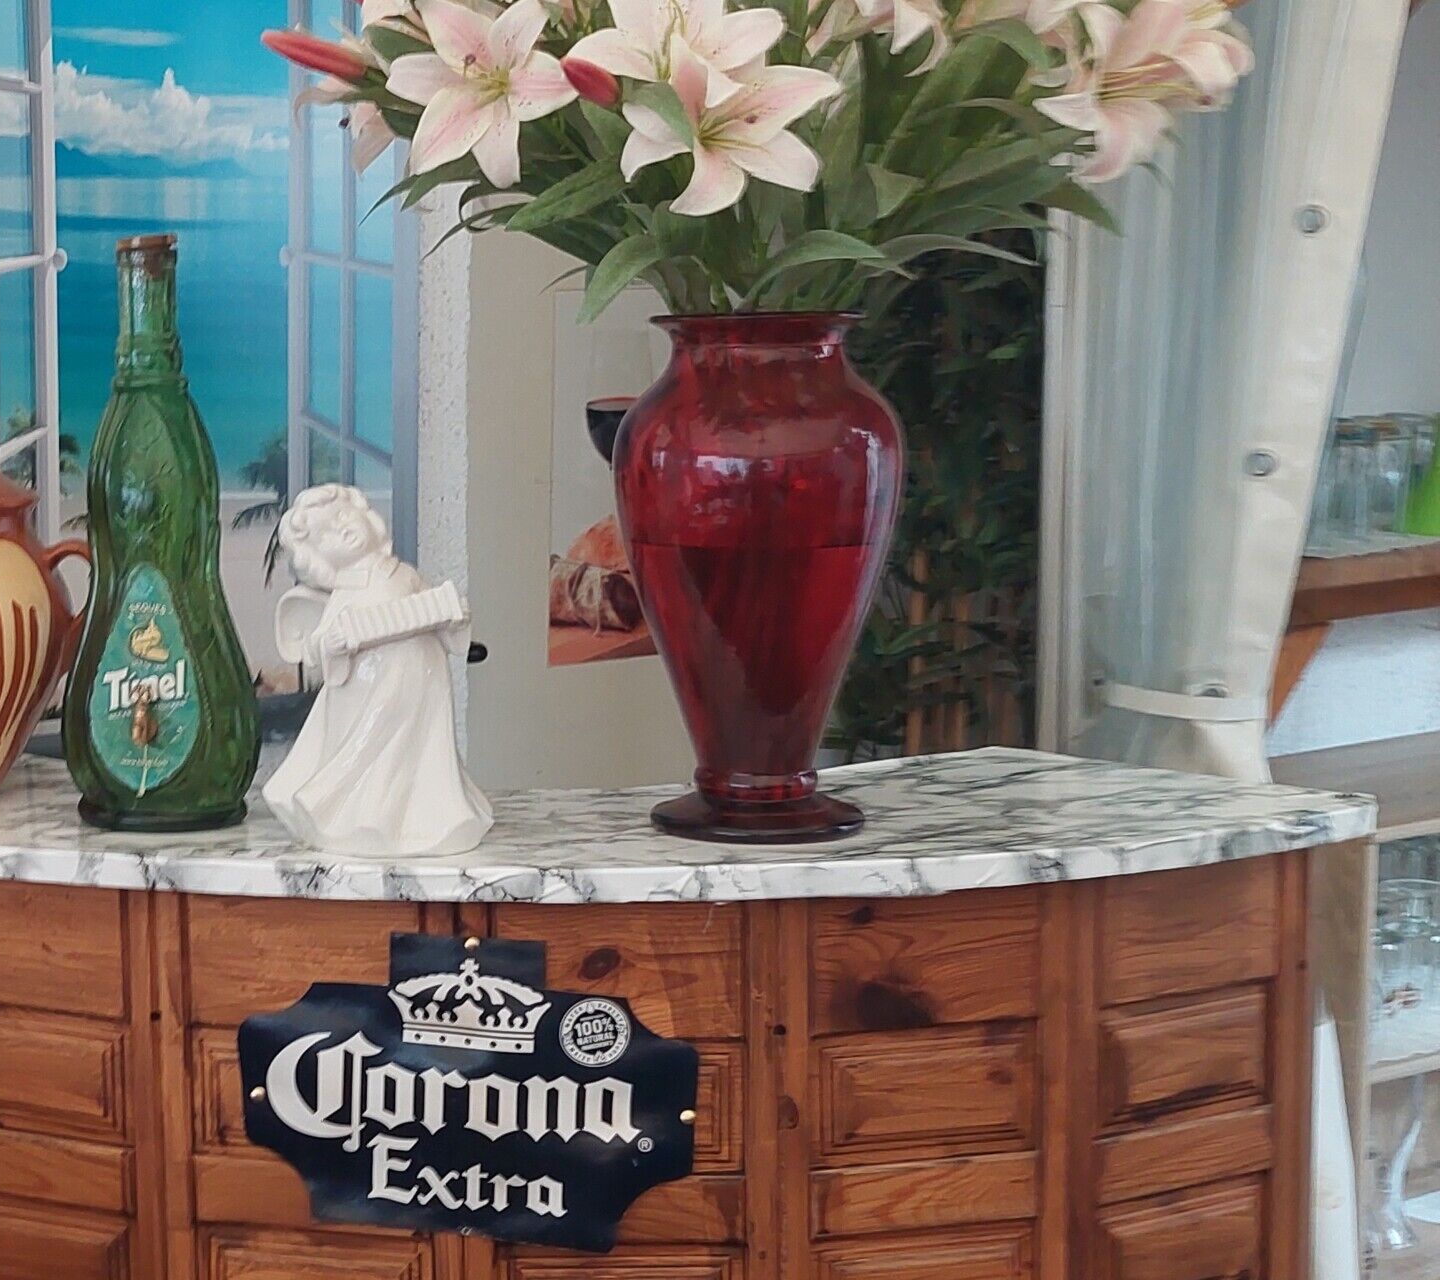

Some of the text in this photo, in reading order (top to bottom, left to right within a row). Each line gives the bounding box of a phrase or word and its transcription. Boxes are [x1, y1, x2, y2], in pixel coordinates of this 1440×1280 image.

[573, 1016, 615, 1038] 100%
[265, 1029, 643, 1153] Corona
[366, 1131, 568, 1219] Extra
